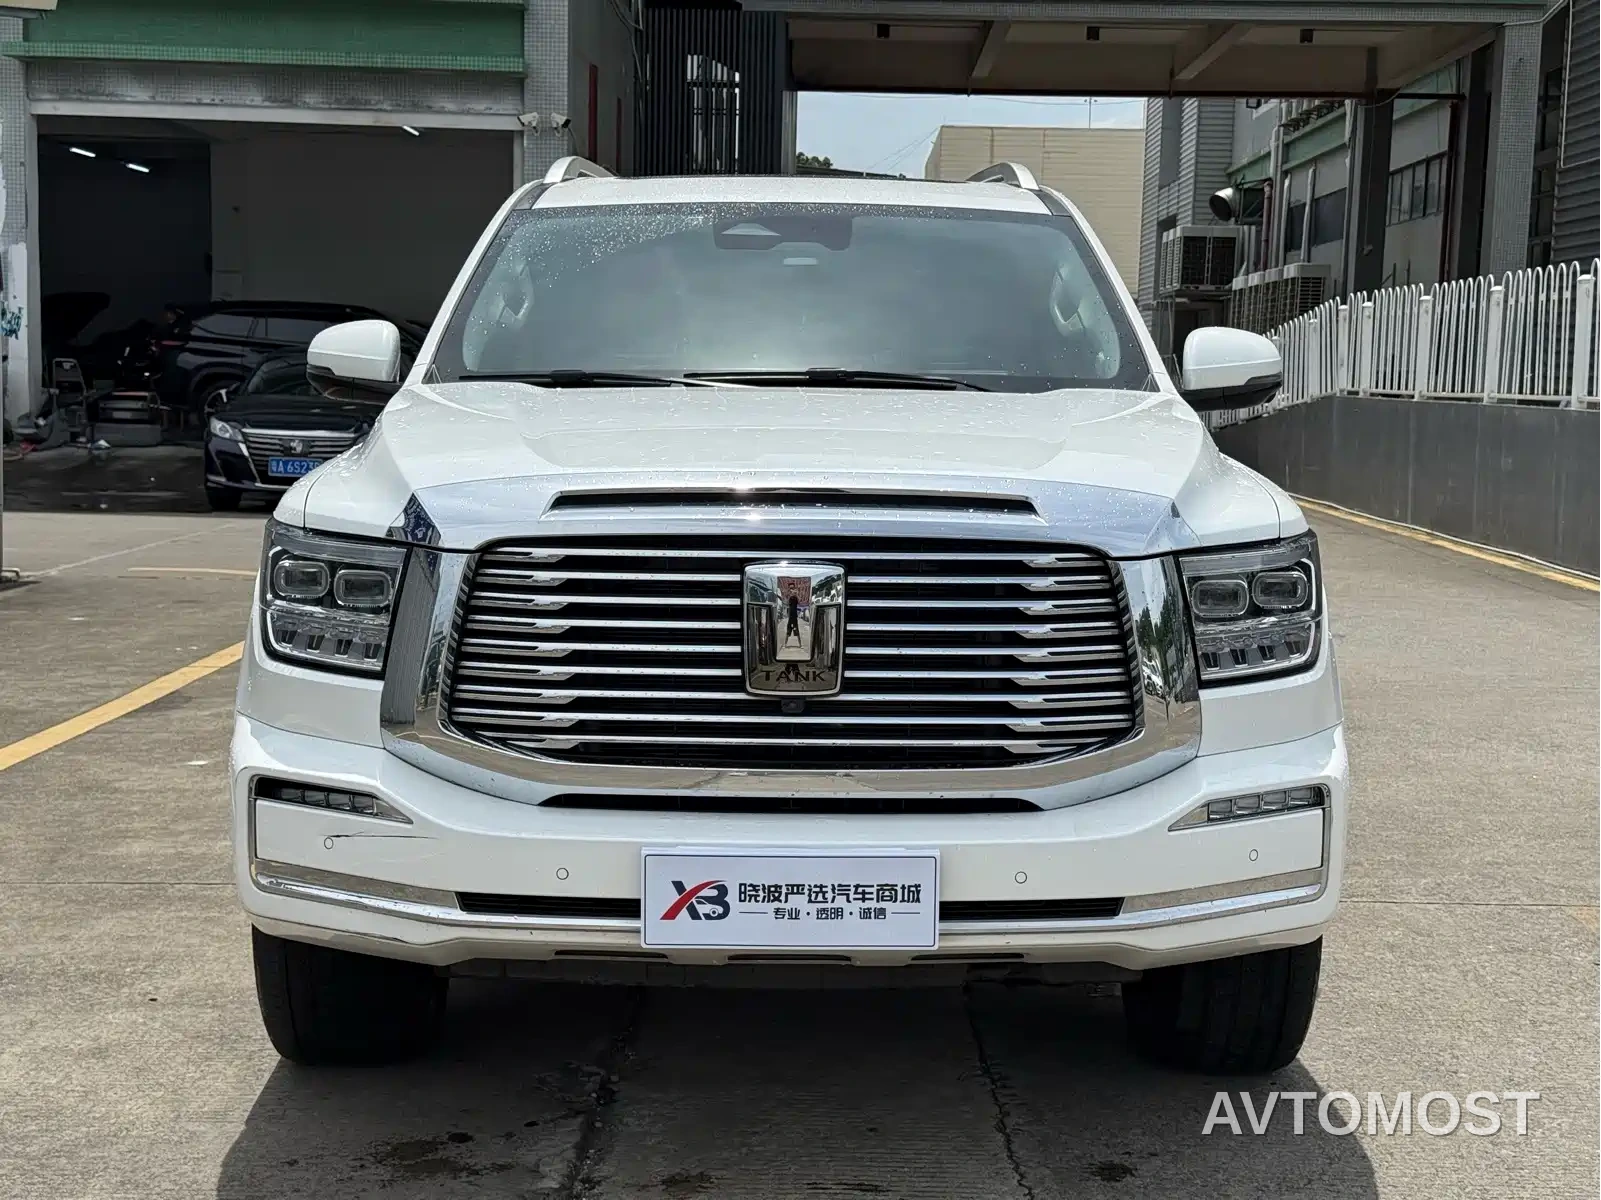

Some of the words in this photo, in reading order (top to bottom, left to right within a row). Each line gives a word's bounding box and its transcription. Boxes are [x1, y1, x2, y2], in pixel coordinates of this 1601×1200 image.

[761, 670, 826, 682] TANK
[738, 882, 922, 904] 晓波严选汽车商城
